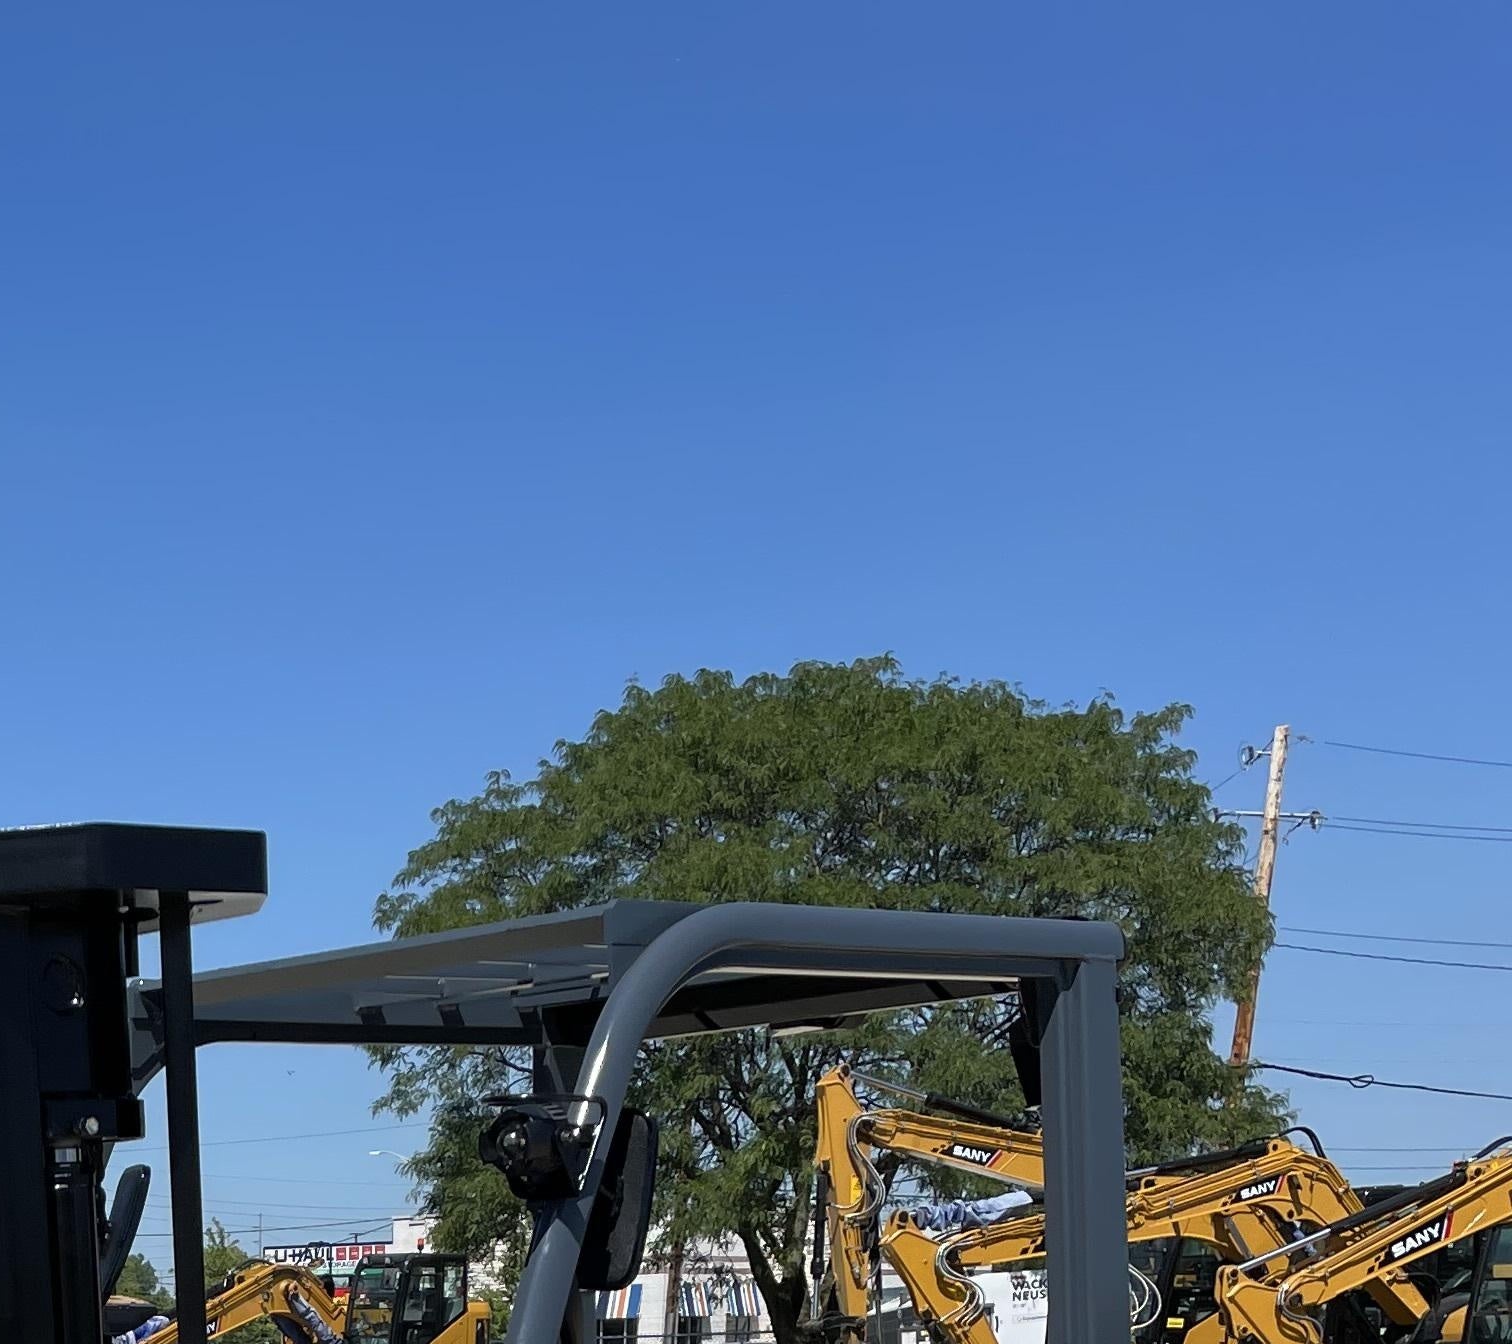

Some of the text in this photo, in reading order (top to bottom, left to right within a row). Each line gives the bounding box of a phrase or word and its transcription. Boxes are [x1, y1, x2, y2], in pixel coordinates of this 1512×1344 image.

[952, 1145, 991, 1163] SANY
[1240, 1180, 1276, 1199] SANY
[1391, 1222, 1440, 1258] SANY
[1011, 1279, 1048, 1291] WACK
[1012, 1290, 1047, 1302] NEUS
